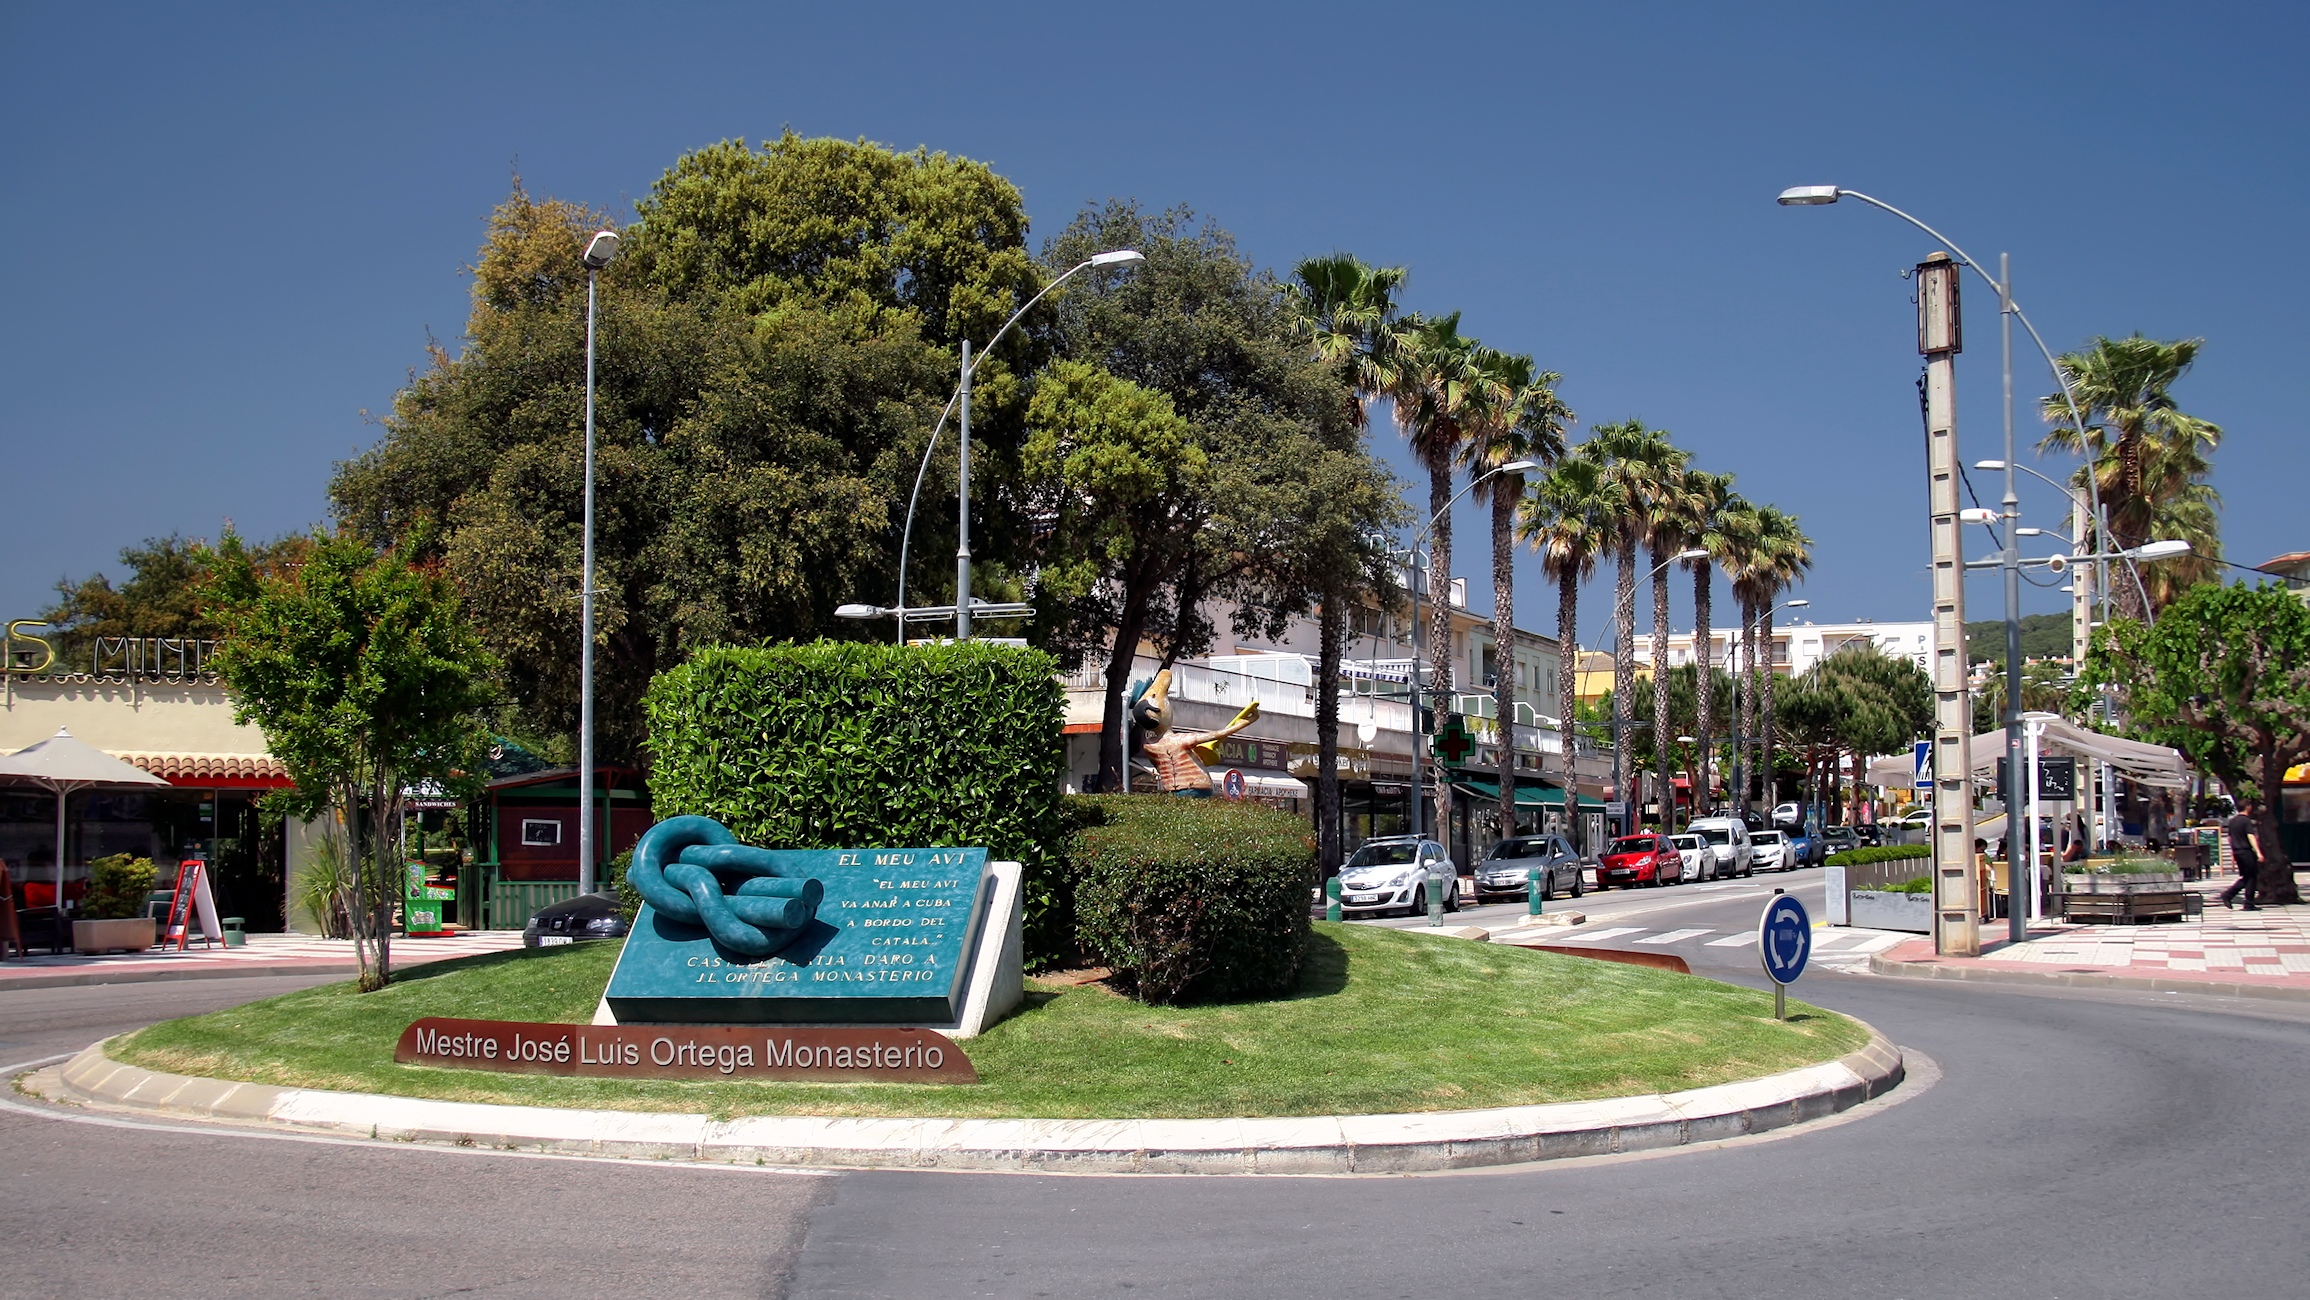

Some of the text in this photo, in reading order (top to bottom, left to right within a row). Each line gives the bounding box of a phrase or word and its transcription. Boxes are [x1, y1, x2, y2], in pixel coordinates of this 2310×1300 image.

[1219, 743, 1244, 759] ACIA
[838, 852, 966, 866] EL MEU AVI
[899, 880, 929, 889] MEU
[933, 880, 960, 889] AVI
[841, 900, 857, 908] VA
[915, 899, 952, 907] CUBA
[864, 918, 913, 927] BORDO
[920, 917, 946, 926] DEL
[923, 953, 936, 965] A
[725, 971, 799, 983] ORTEGA
[812, 970, 934, 982] MONASTERIO
[416, 1027, 944, 1074] Mestre José Luis Ortega Monasterio
